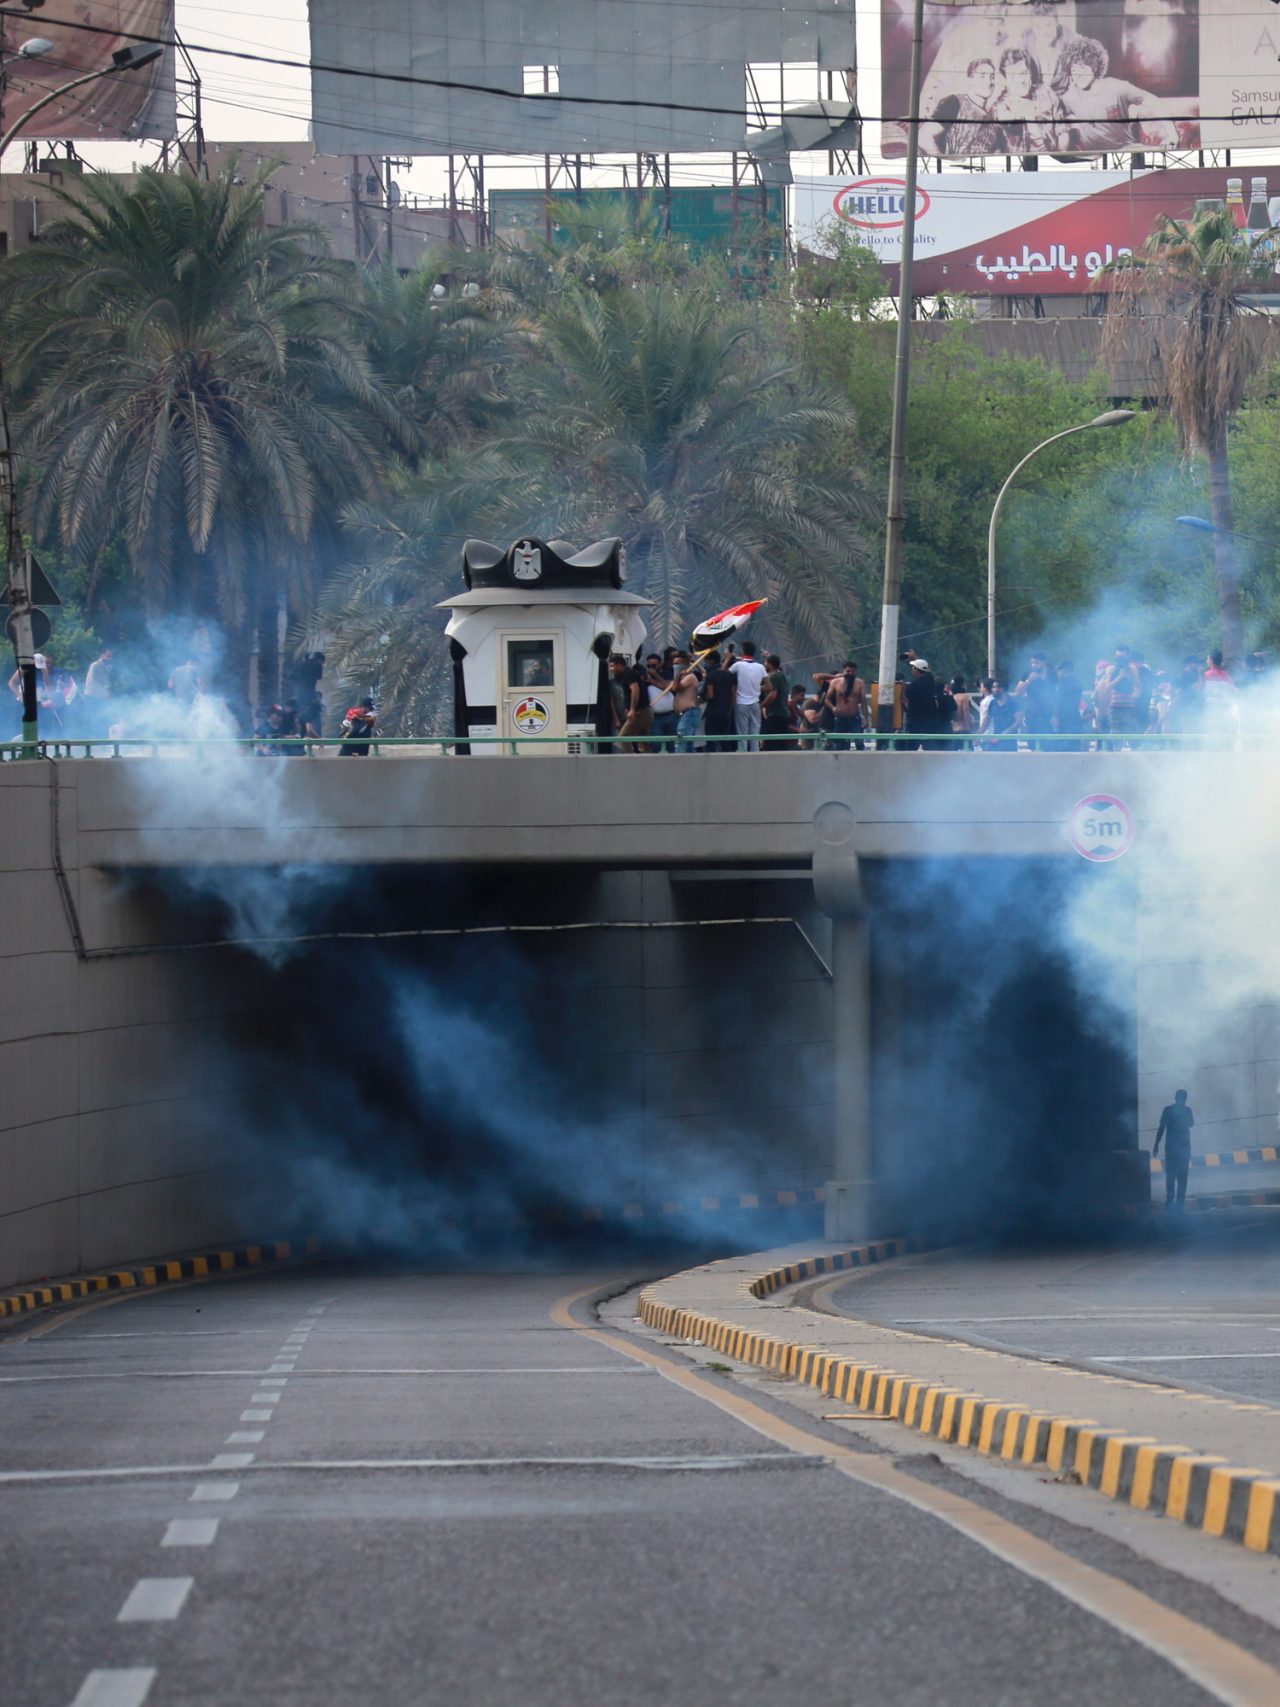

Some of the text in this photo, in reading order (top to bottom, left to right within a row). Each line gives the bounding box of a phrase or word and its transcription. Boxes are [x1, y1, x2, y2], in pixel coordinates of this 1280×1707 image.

[883, 235, 894, 245] to
[976, 244, 1078, 280] بالطيب
[1083, 818, 1122, 837] 5m
